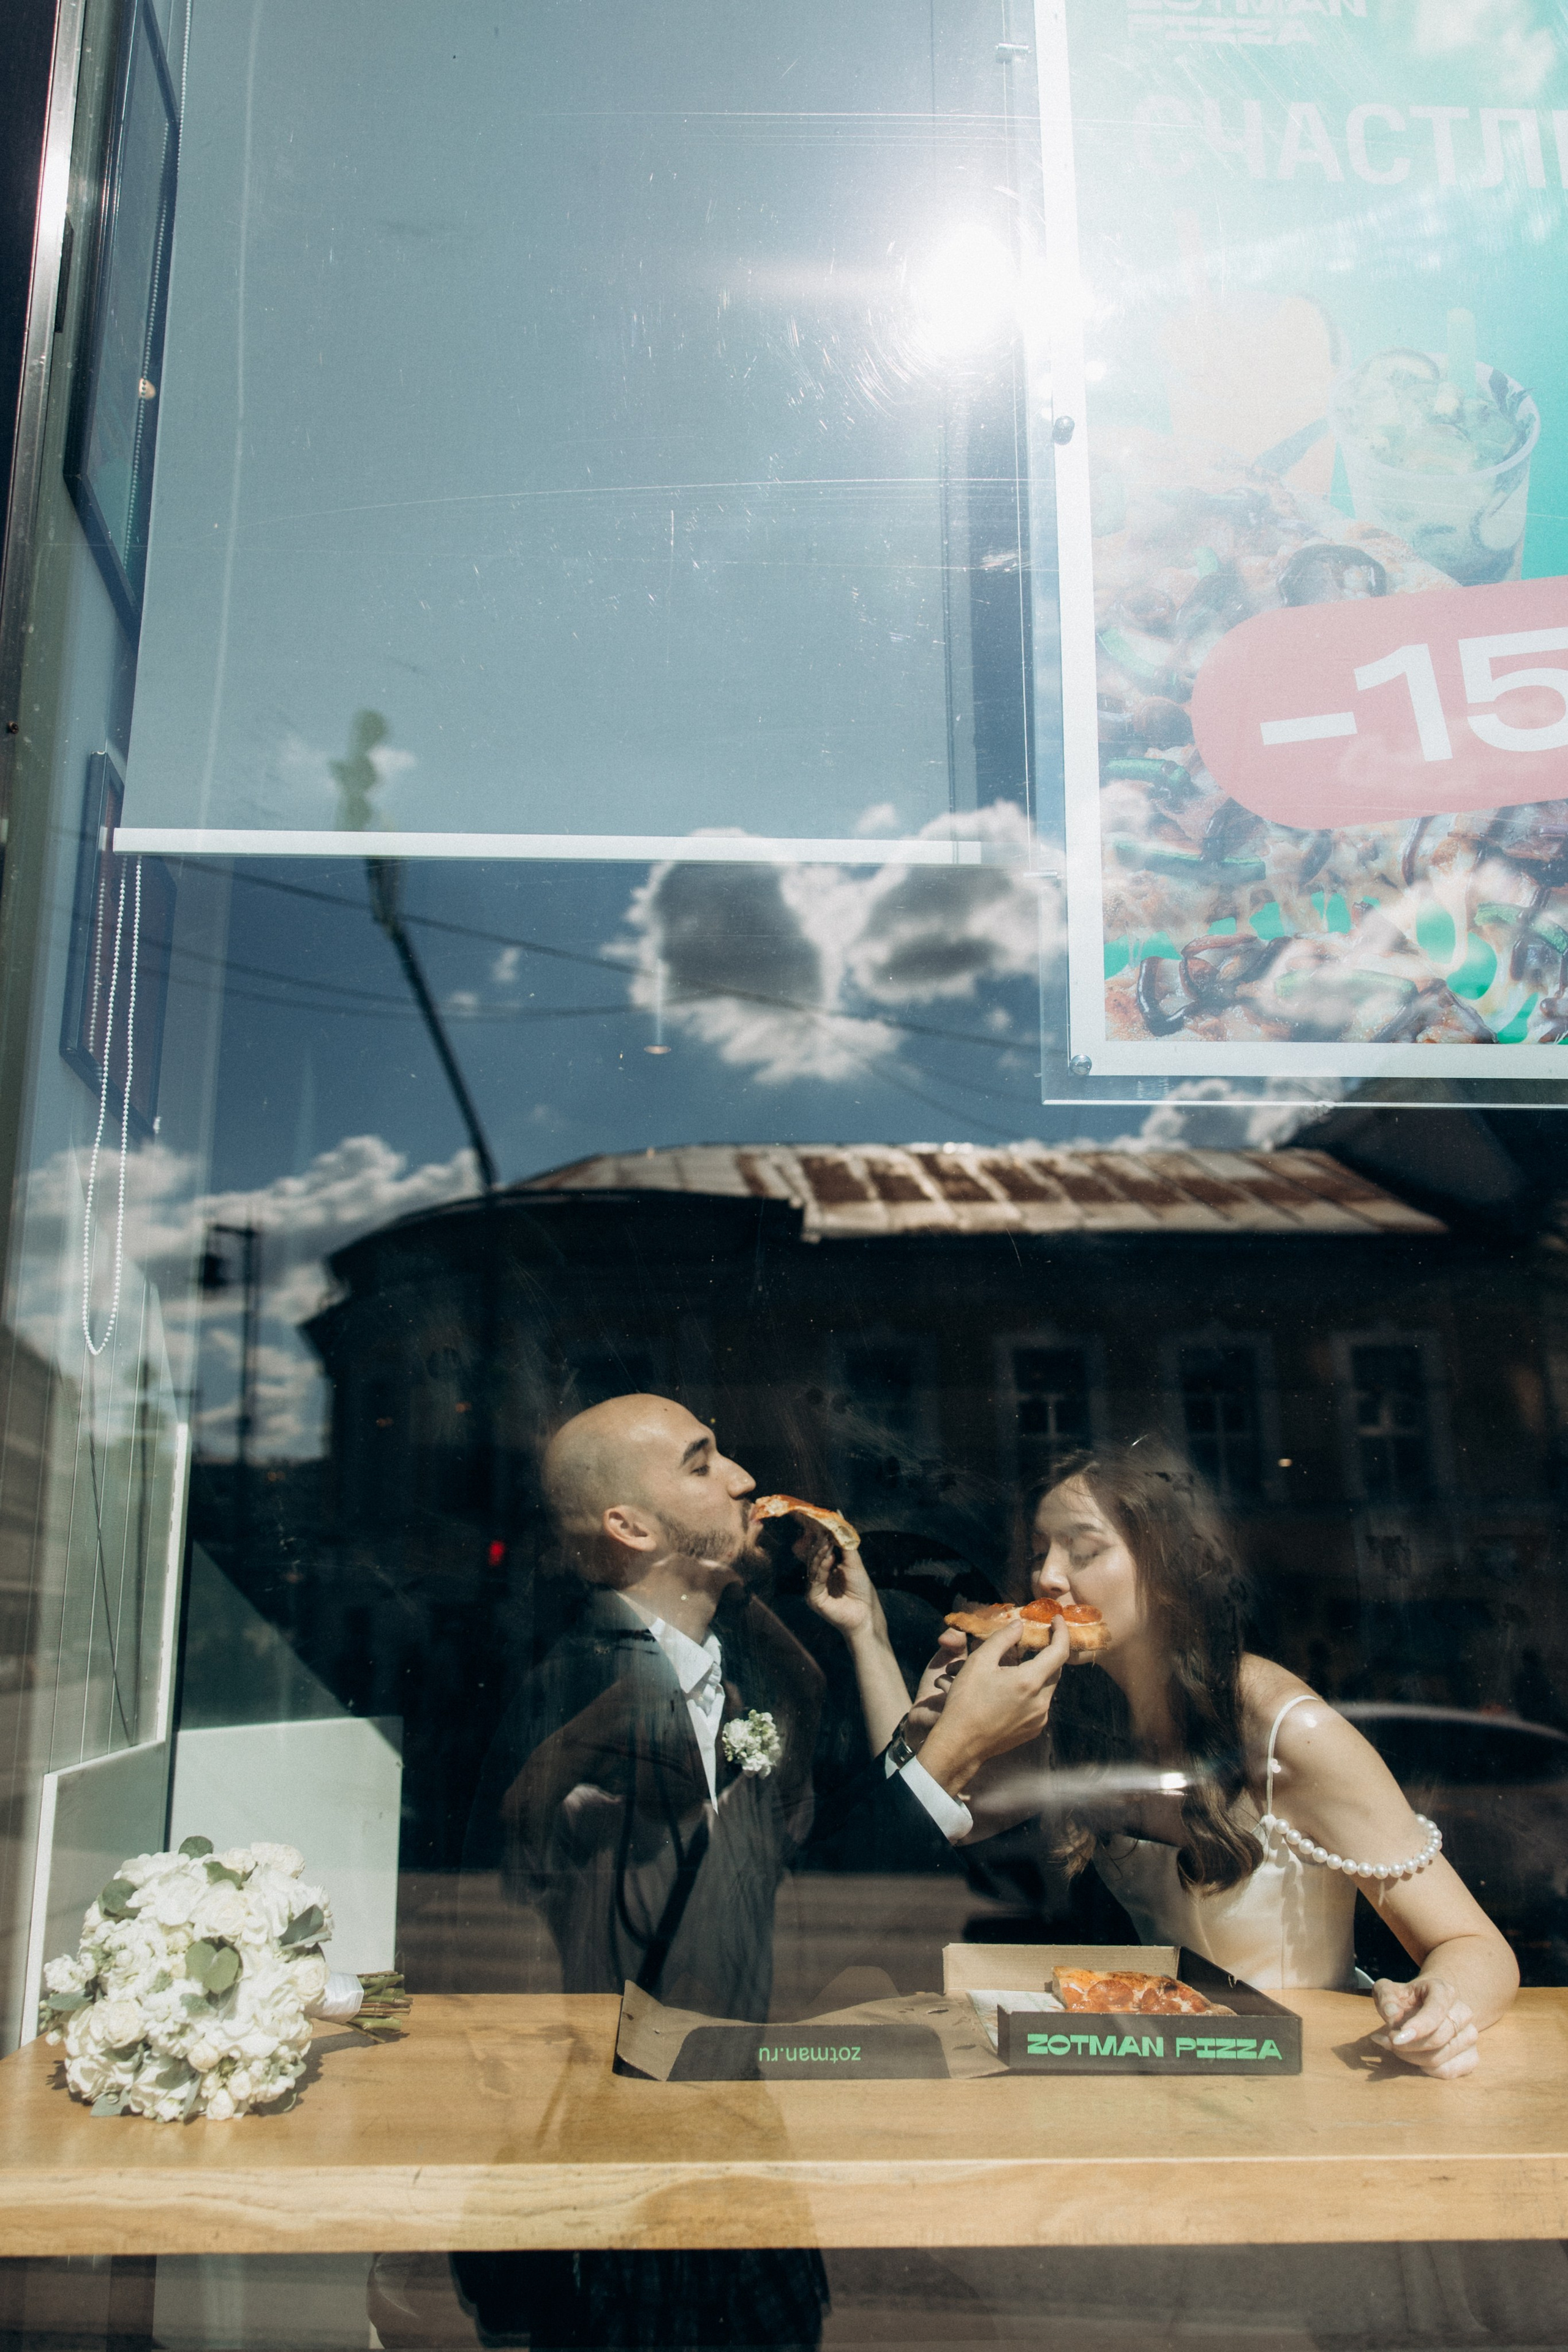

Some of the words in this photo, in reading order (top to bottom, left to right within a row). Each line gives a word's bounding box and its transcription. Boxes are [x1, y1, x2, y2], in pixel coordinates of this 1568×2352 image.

[1128, 14, 1317, 46] PIZZA
[1132, 95, 1568, 190] СЧАСТЛ
[759, 2046, 861, 2064] zotman.ru
[1027, 2034, 1164, 2057] ZOTMAN
[1176, 2037, 1283, 2060] PIZZA
